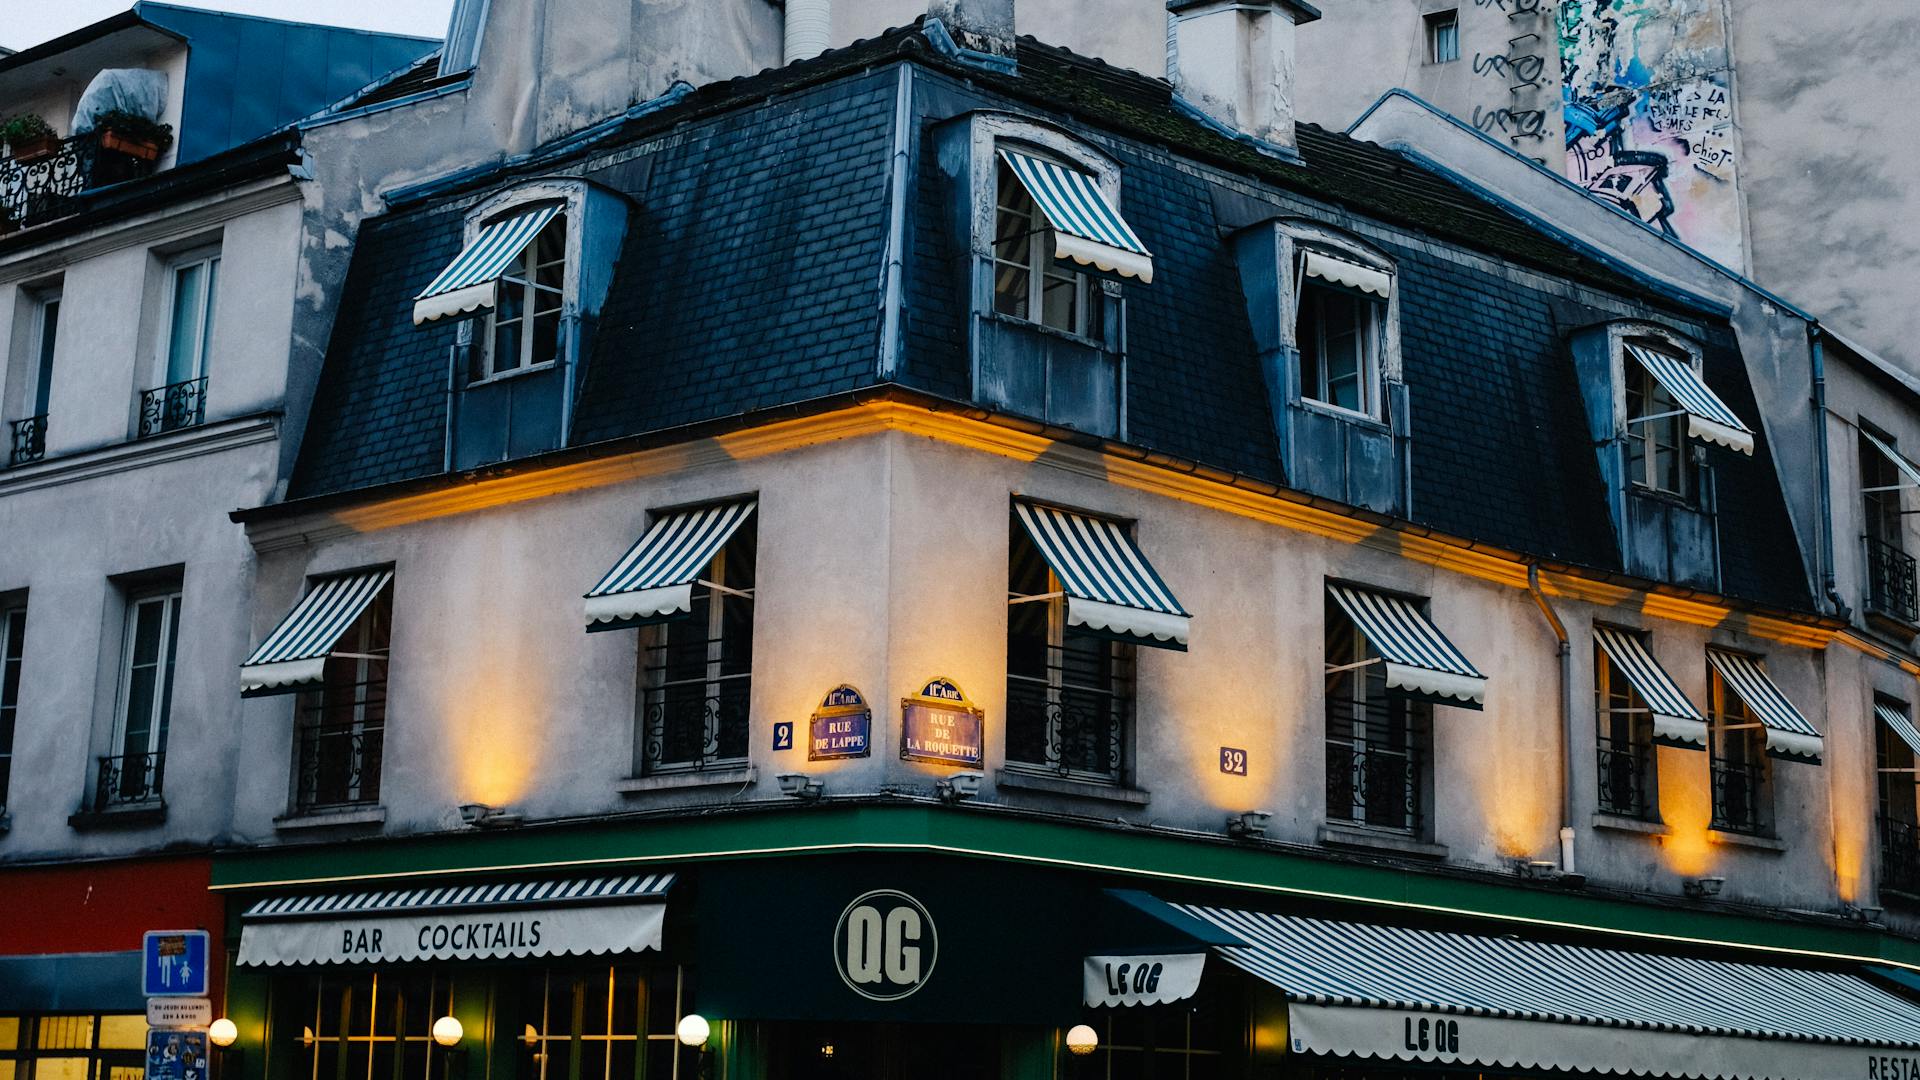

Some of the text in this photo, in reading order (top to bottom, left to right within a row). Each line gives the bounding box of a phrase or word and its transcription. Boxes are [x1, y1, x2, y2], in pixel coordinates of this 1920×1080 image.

[828, 721, 852, 734] RUE
[930, 712, 955, 727] RUE
[777, 725, 789, 747] 2
[815, 735, 864, 750] DE LAPPE
[935, 728, 951, 740] DE
[906, 737, 979, 758] LA ROQUETTE
[1224, 750, 1243, 773] 32
[342, 920, 541, 954] BAR COCKTAILS
[847, 905, 921, 985] QG
[1105, 963, 1130, 996] LE
[1405, 1017, 1429, 1052] LE
[1868, 1055, 1920, 1080] RESTA
